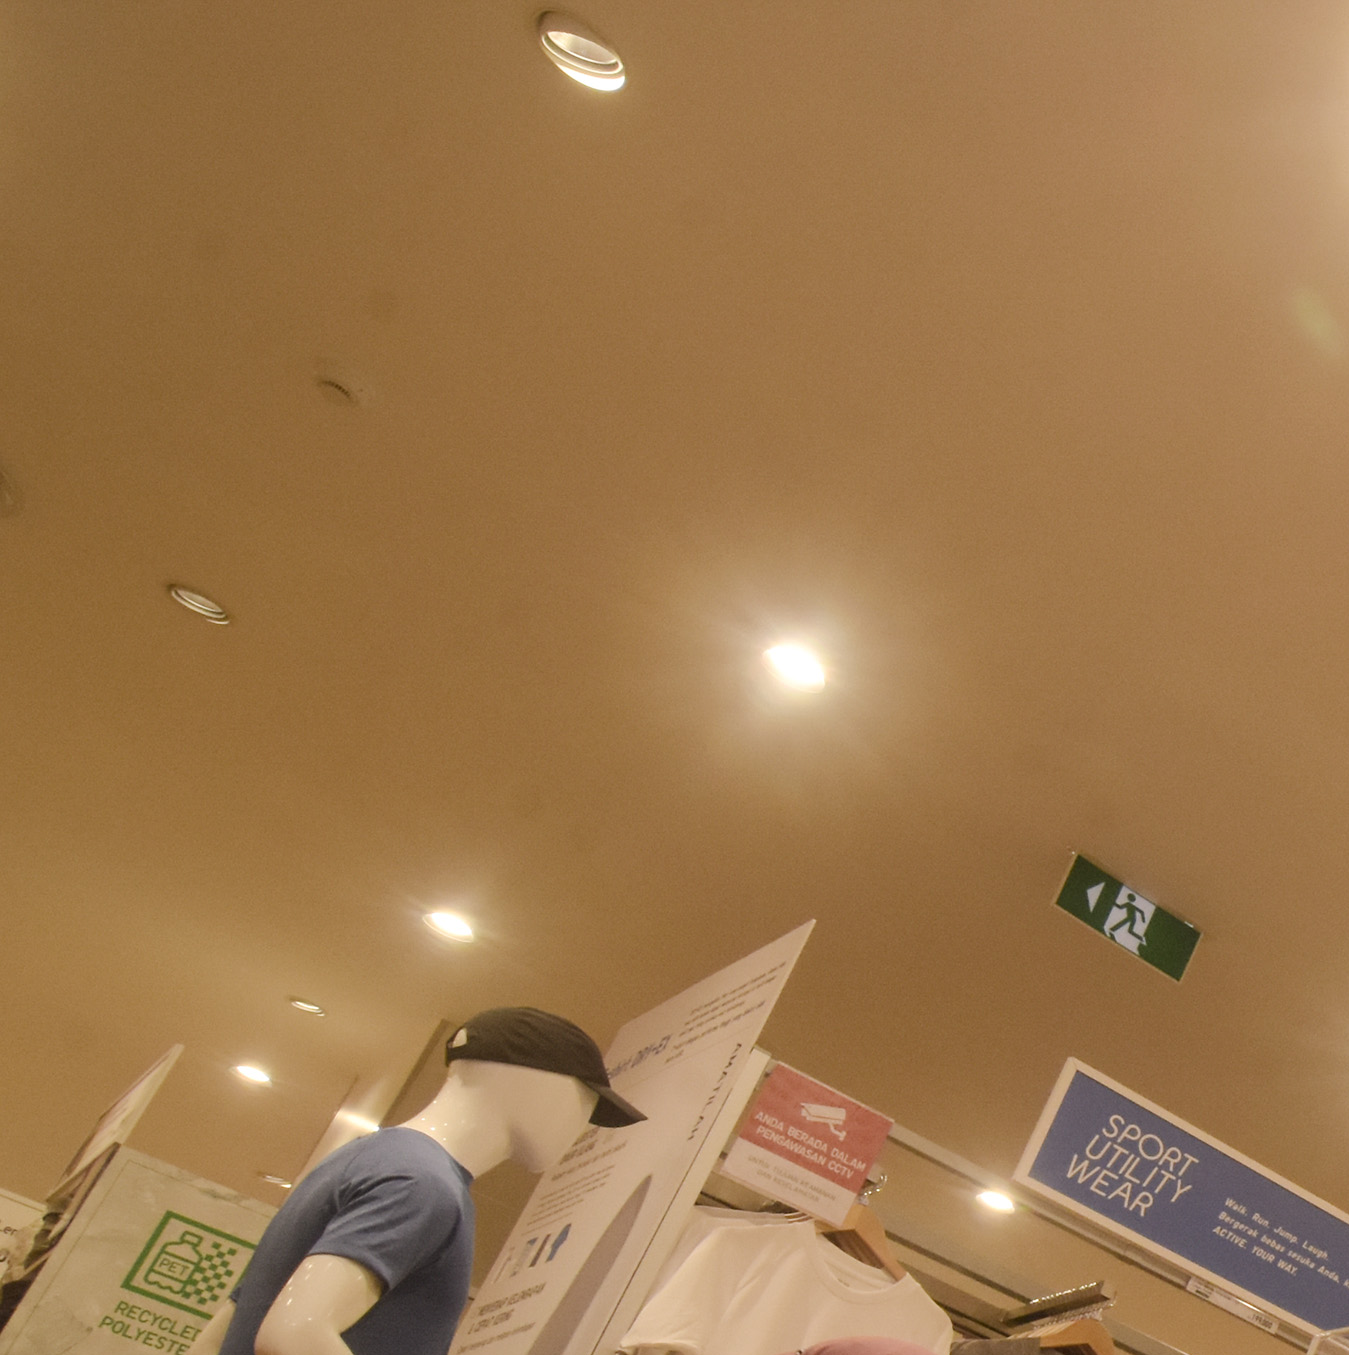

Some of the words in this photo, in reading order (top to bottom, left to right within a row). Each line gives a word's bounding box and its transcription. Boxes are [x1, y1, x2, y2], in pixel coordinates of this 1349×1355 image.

[754, 1111, 785, 1132] ANDA
[787, 1126, 829, 1152] BERADA
[830, 1148, 867, 1171] DALAM
[756, 1126, 828, 1165] PENGAWASAN
[828, 1160, 855, 1179] CCTV
[1085, 1134, 1193, 1204] UTILITY
[1101, 1114, 1199, 1177] SPORT
[1066, 1154, 1154, 1217] WEAR
[1218, 1211, 1259, 1239] Bergerak
[1260, 1234, 1285, 1252] bebas
[1251, 1245, 1276, 1264] YOUR
[158, 1258, 190, 1277] PET
